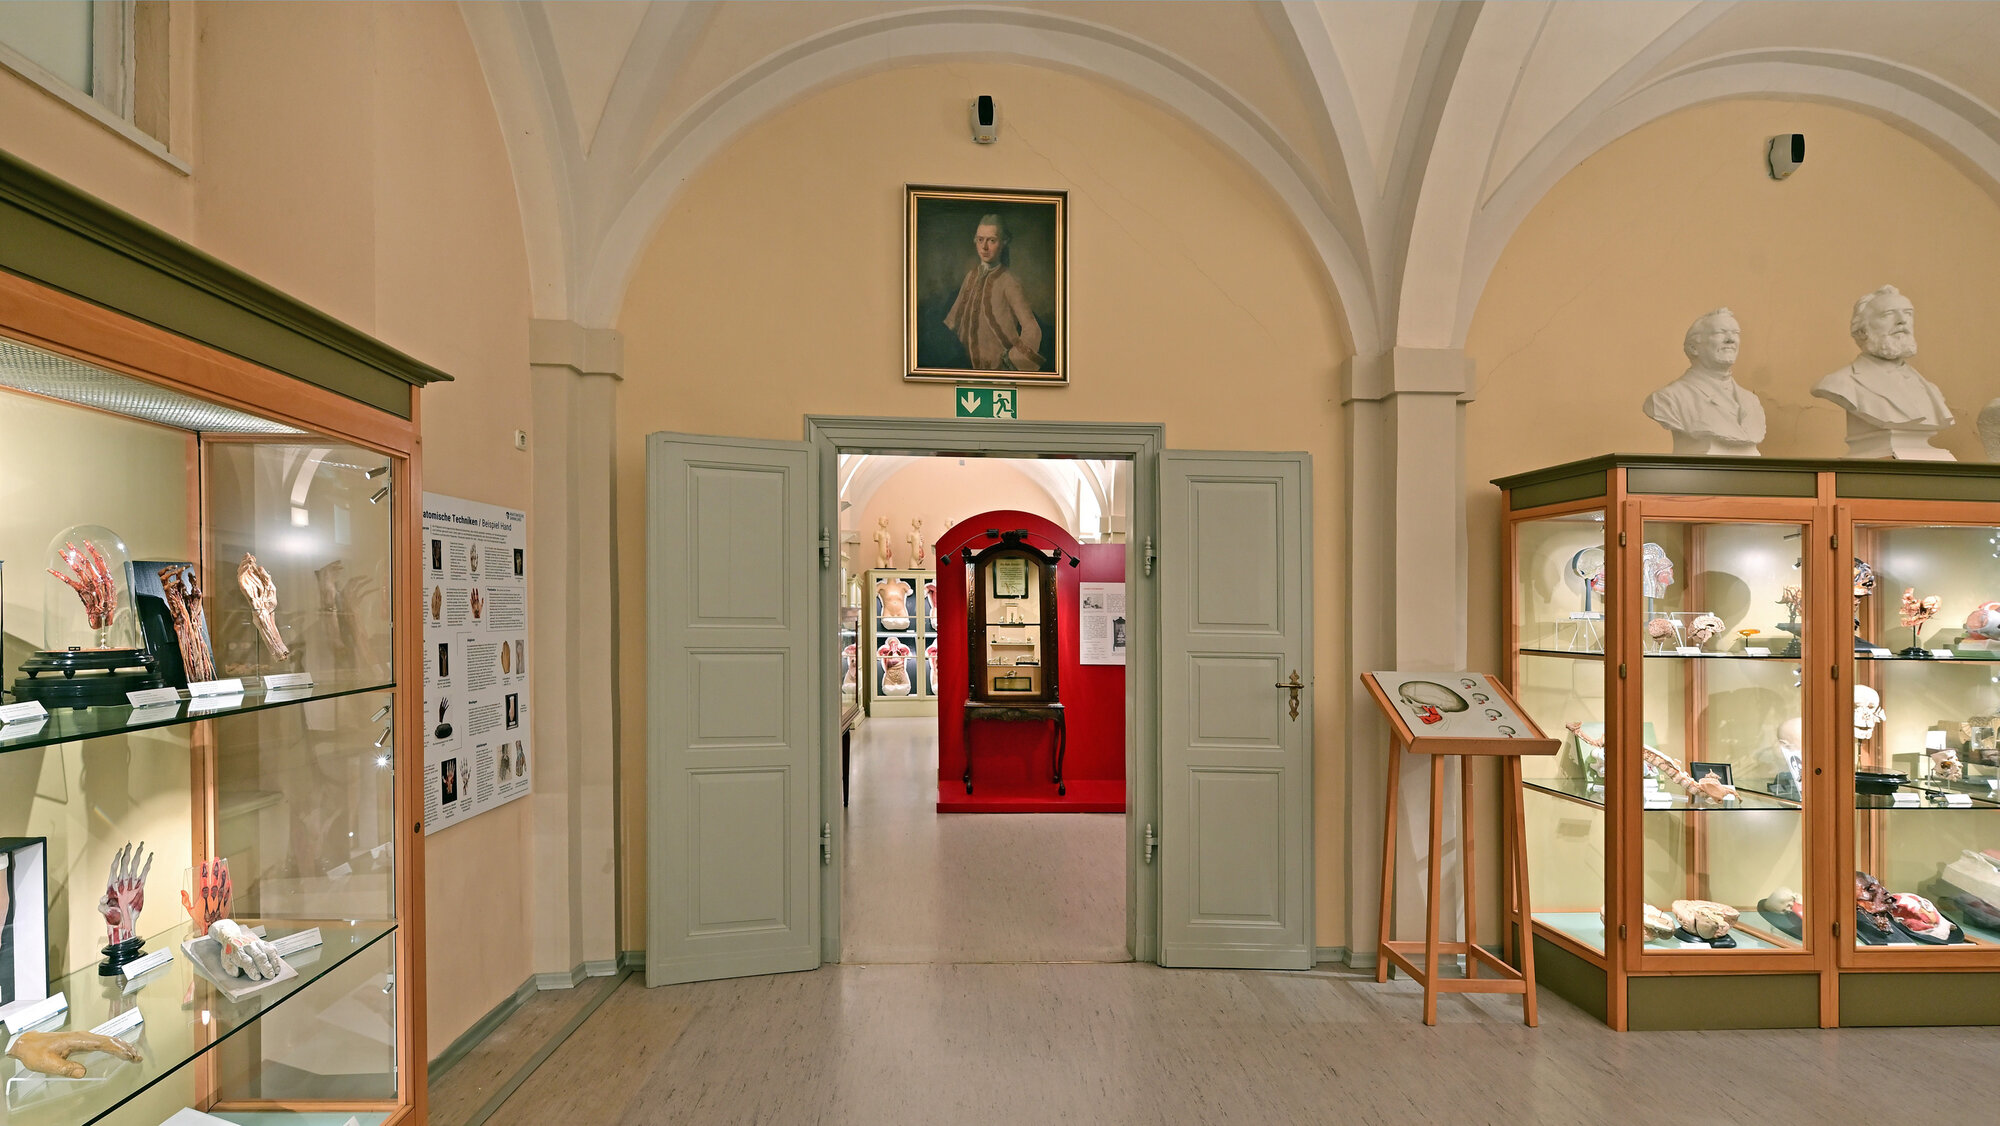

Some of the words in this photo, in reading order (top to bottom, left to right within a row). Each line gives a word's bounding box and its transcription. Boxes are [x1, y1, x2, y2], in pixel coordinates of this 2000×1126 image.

[452, 513, 478, 526] Techniken
[482, 518, 500, 530] Beispiel
[500, 523, 512, 531] Hand
